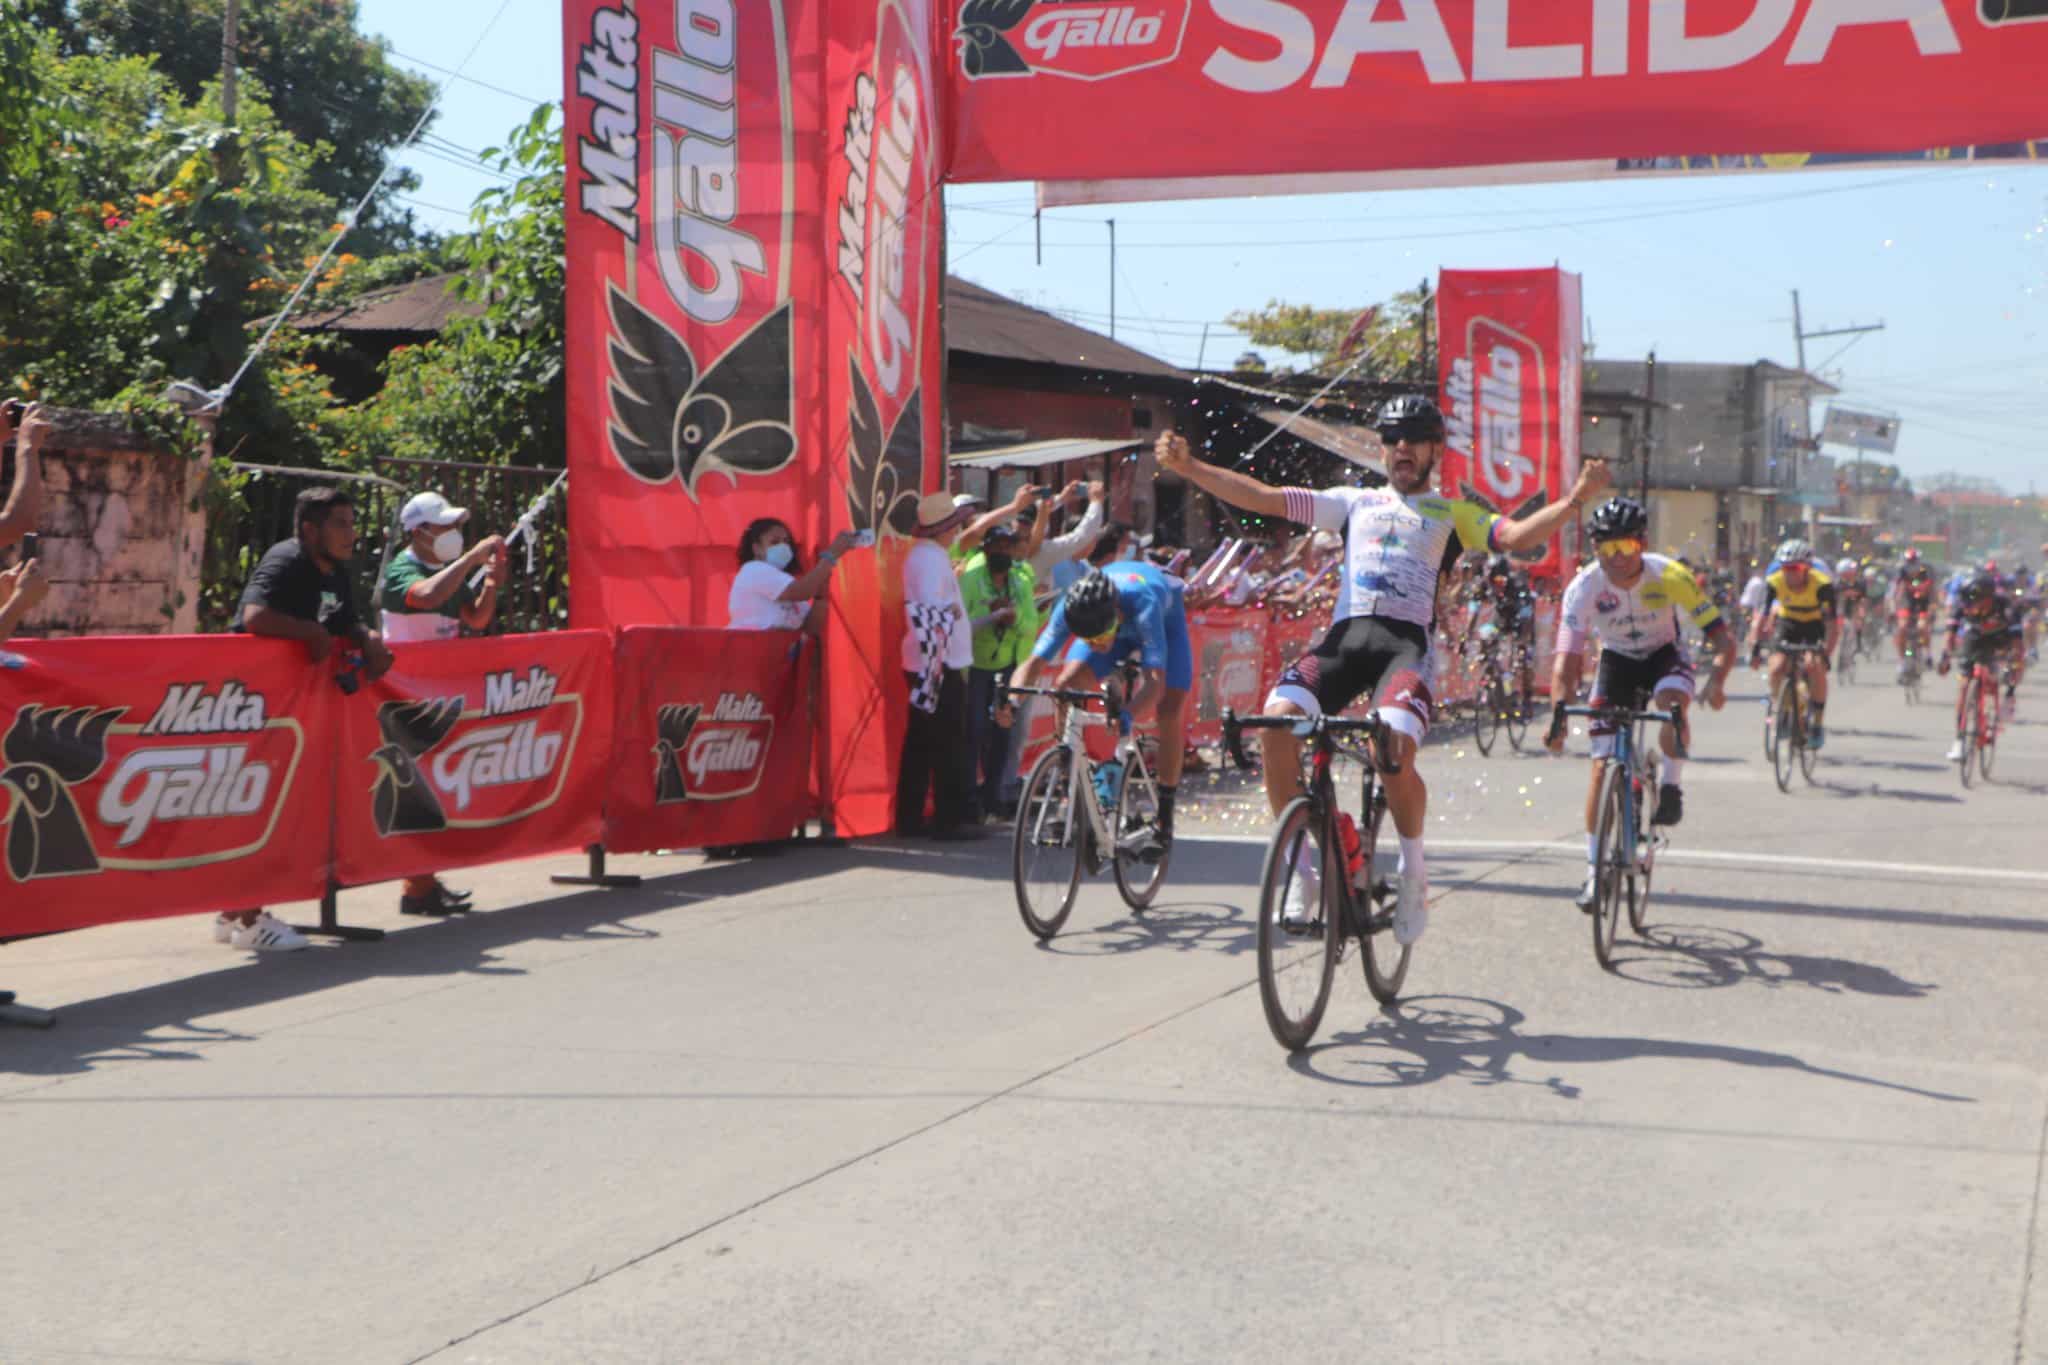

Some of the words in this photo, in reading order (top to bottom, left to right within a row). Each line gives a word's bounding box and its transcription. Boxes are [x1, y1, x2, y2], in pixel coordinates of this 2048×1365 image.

[1024, 7, 1162, 60] Gallo
[577, 3, 640, 245] Malta
[651, 0, 767, 324] Gallo
[838, 70, 878, 312] Malta
[139, 680, 268, 736] Malta
[480, 665, 557, 720] Malta
[711, 692, 764, 721] Malta
[429, 718, 564, 811] Gallo
[686, 727, 761, 788] Gallo
[98, 744, 272, 849] Gallo
